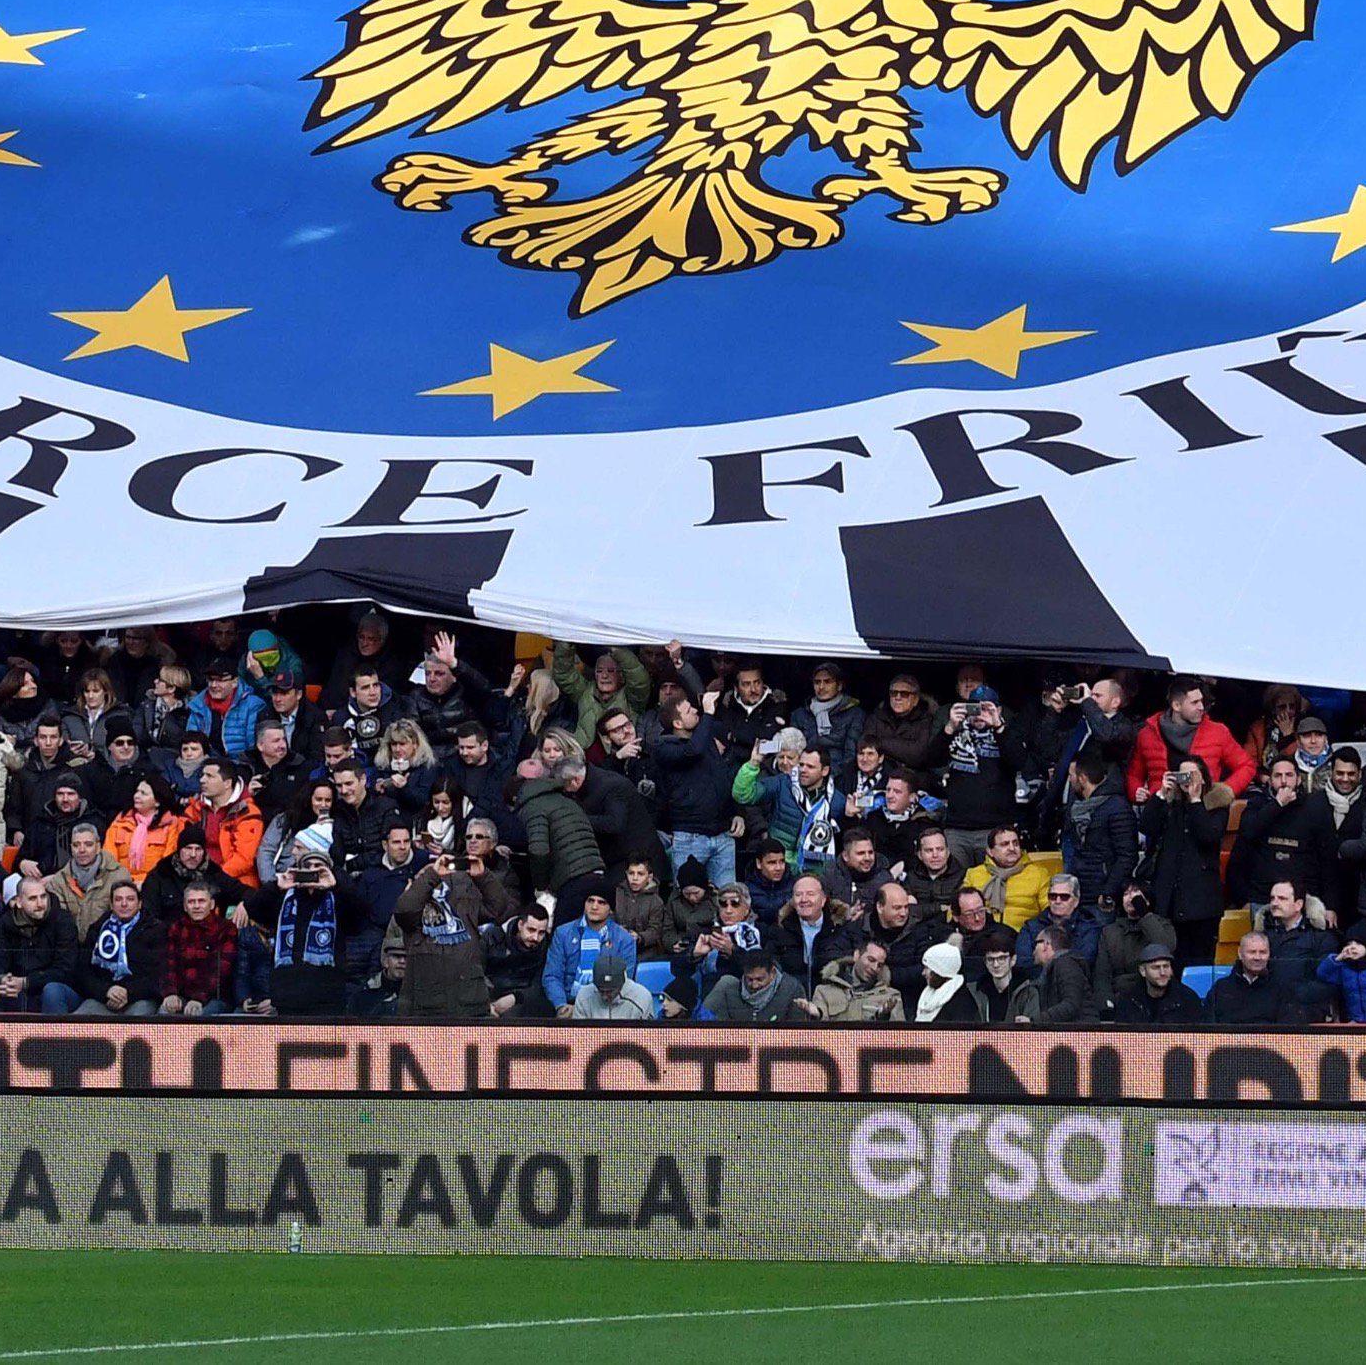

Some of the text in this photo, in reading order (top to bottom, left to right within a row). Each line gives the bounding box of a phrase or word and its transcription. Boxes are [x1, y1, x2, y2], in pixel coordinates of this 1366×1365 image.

[88, 1150, 322, 1229] ALLA
[346, 1152, 723, 1230] TAVOLA!
[848, 1109, 1123, 1203] ersa
[855, 1221, 986, 1259] Agenzia
